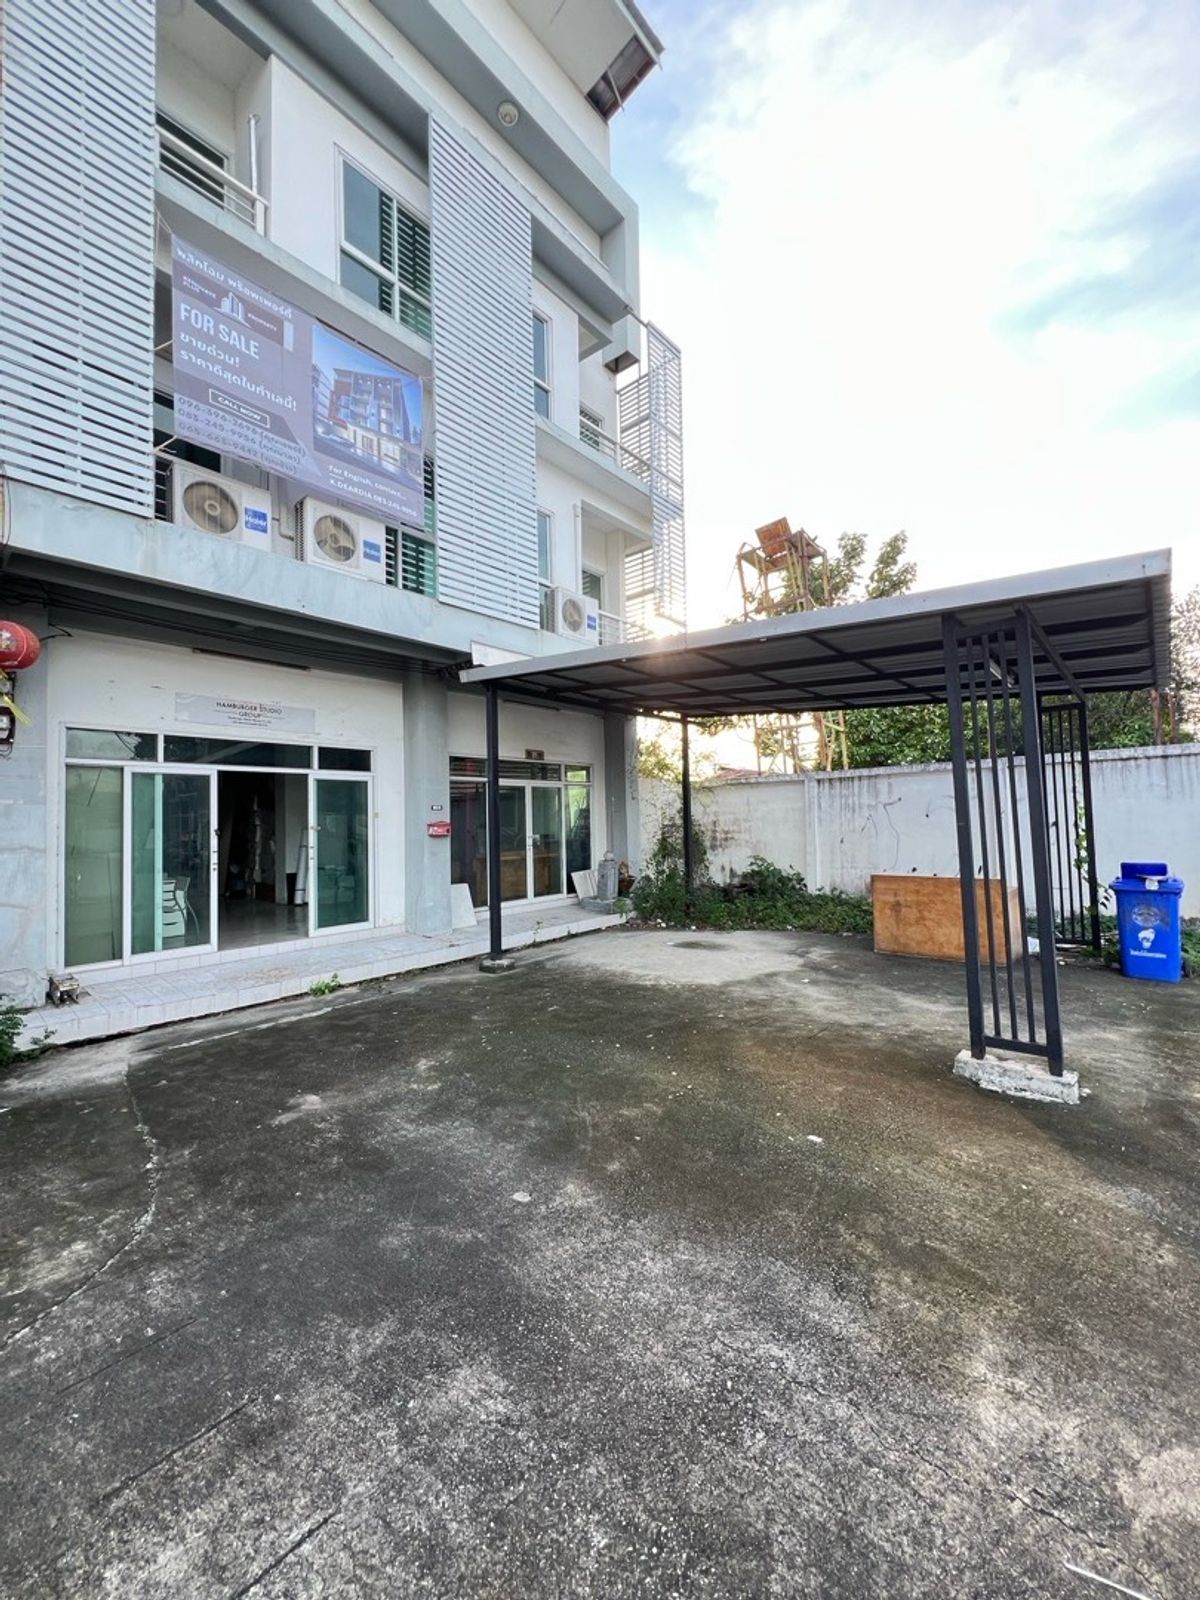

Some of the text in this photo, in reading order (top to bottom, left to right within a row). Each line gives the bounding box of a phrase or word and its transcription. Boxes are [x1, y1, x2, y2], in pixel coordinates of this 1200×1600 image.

[180, 303, 259, 359] FOR SALE
[180, 333, 240, 367] ขายด่วน!
[180, 350, 297, 411] ราคาดีสุดในทำเลนี้!
[218, 397, 262, 420] CALL NOW
[216, 701, 283, 715] HAMBURGER STUDIO
[238, 711, 262, 719] GROUP
